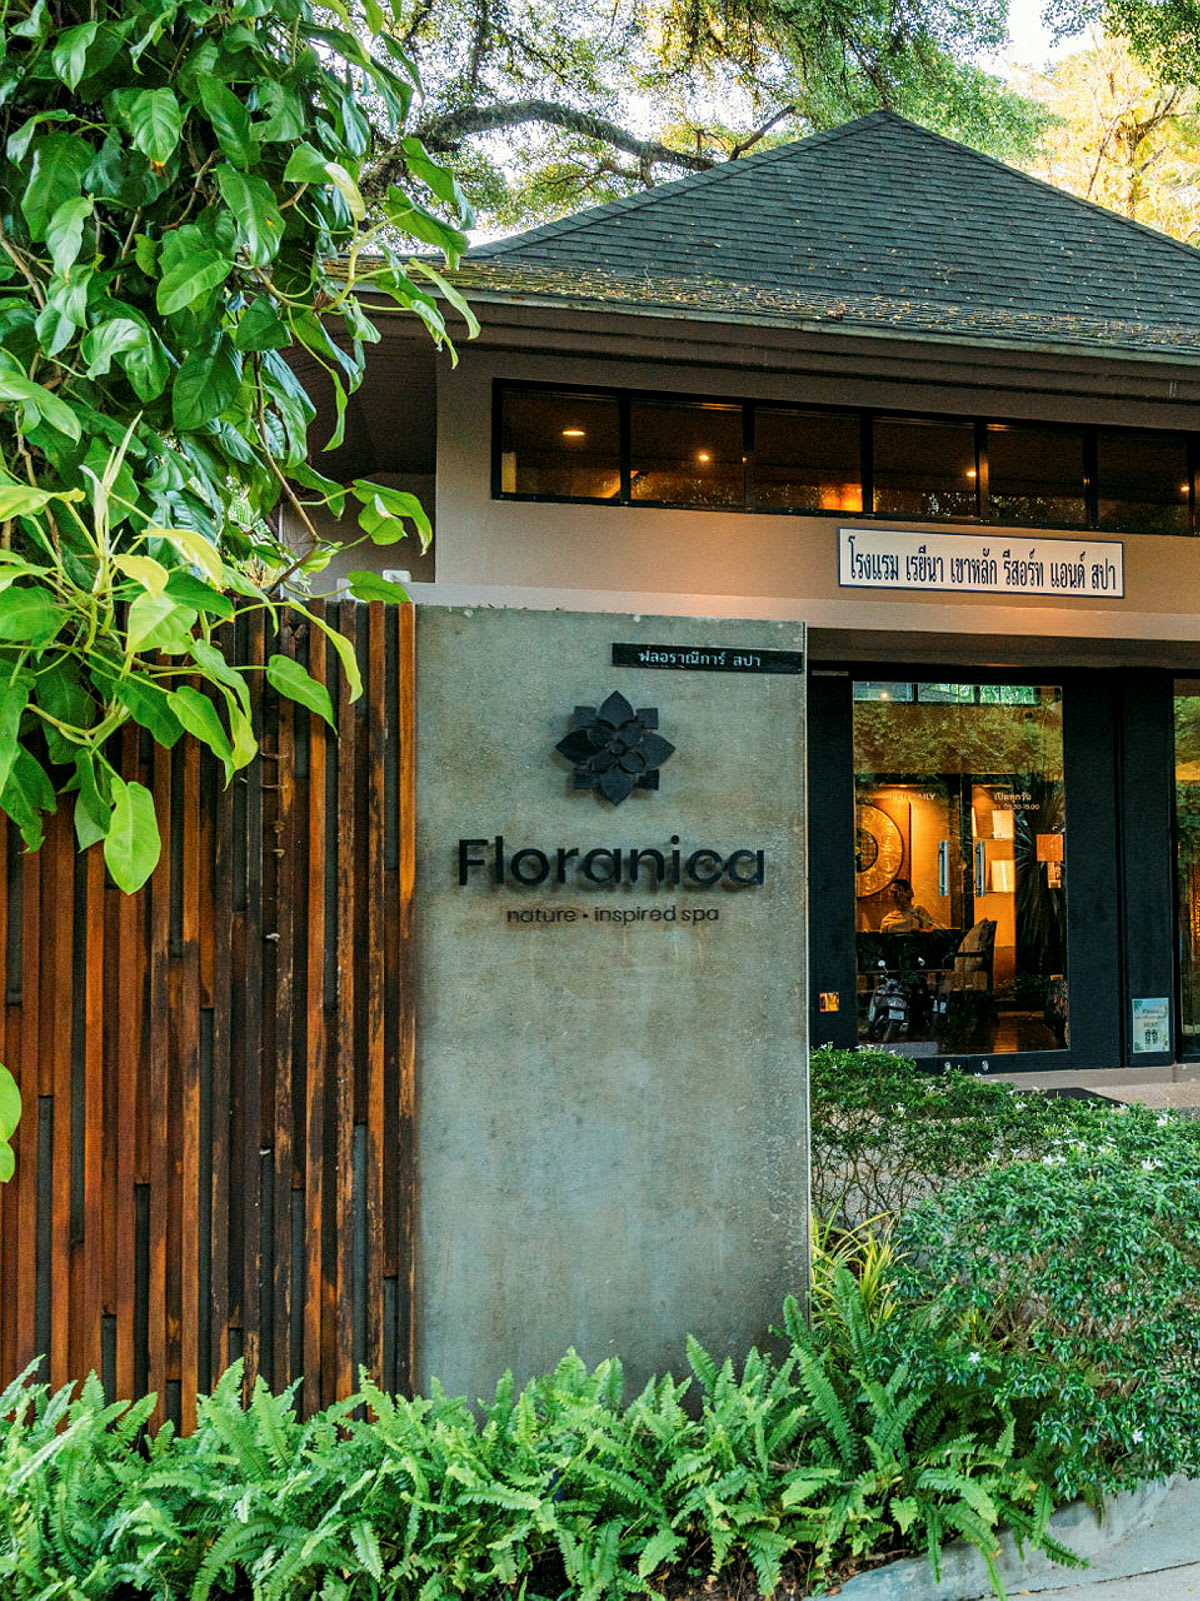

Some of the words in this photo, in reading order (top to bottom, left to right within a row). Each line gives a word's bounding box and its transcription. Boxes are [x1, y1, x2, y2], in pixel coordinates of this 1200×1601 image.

[847, 535, 899, 581] โรงแรม
[950, 548, 998, 585] เขาหลัก
[1002, 548, 1044, 587] รีสอร์ท
[1050, 551, 1086, 589] แอนด์
[1092, 557, 1116, 590] สปา
[733, 655, 761, 667] สปา
[458, 834, 765, 887] Floranica
[506, 908, 578, 924] nature
[594, 904, 677, 926] inspired
[681, 907, 720, 926] spa
